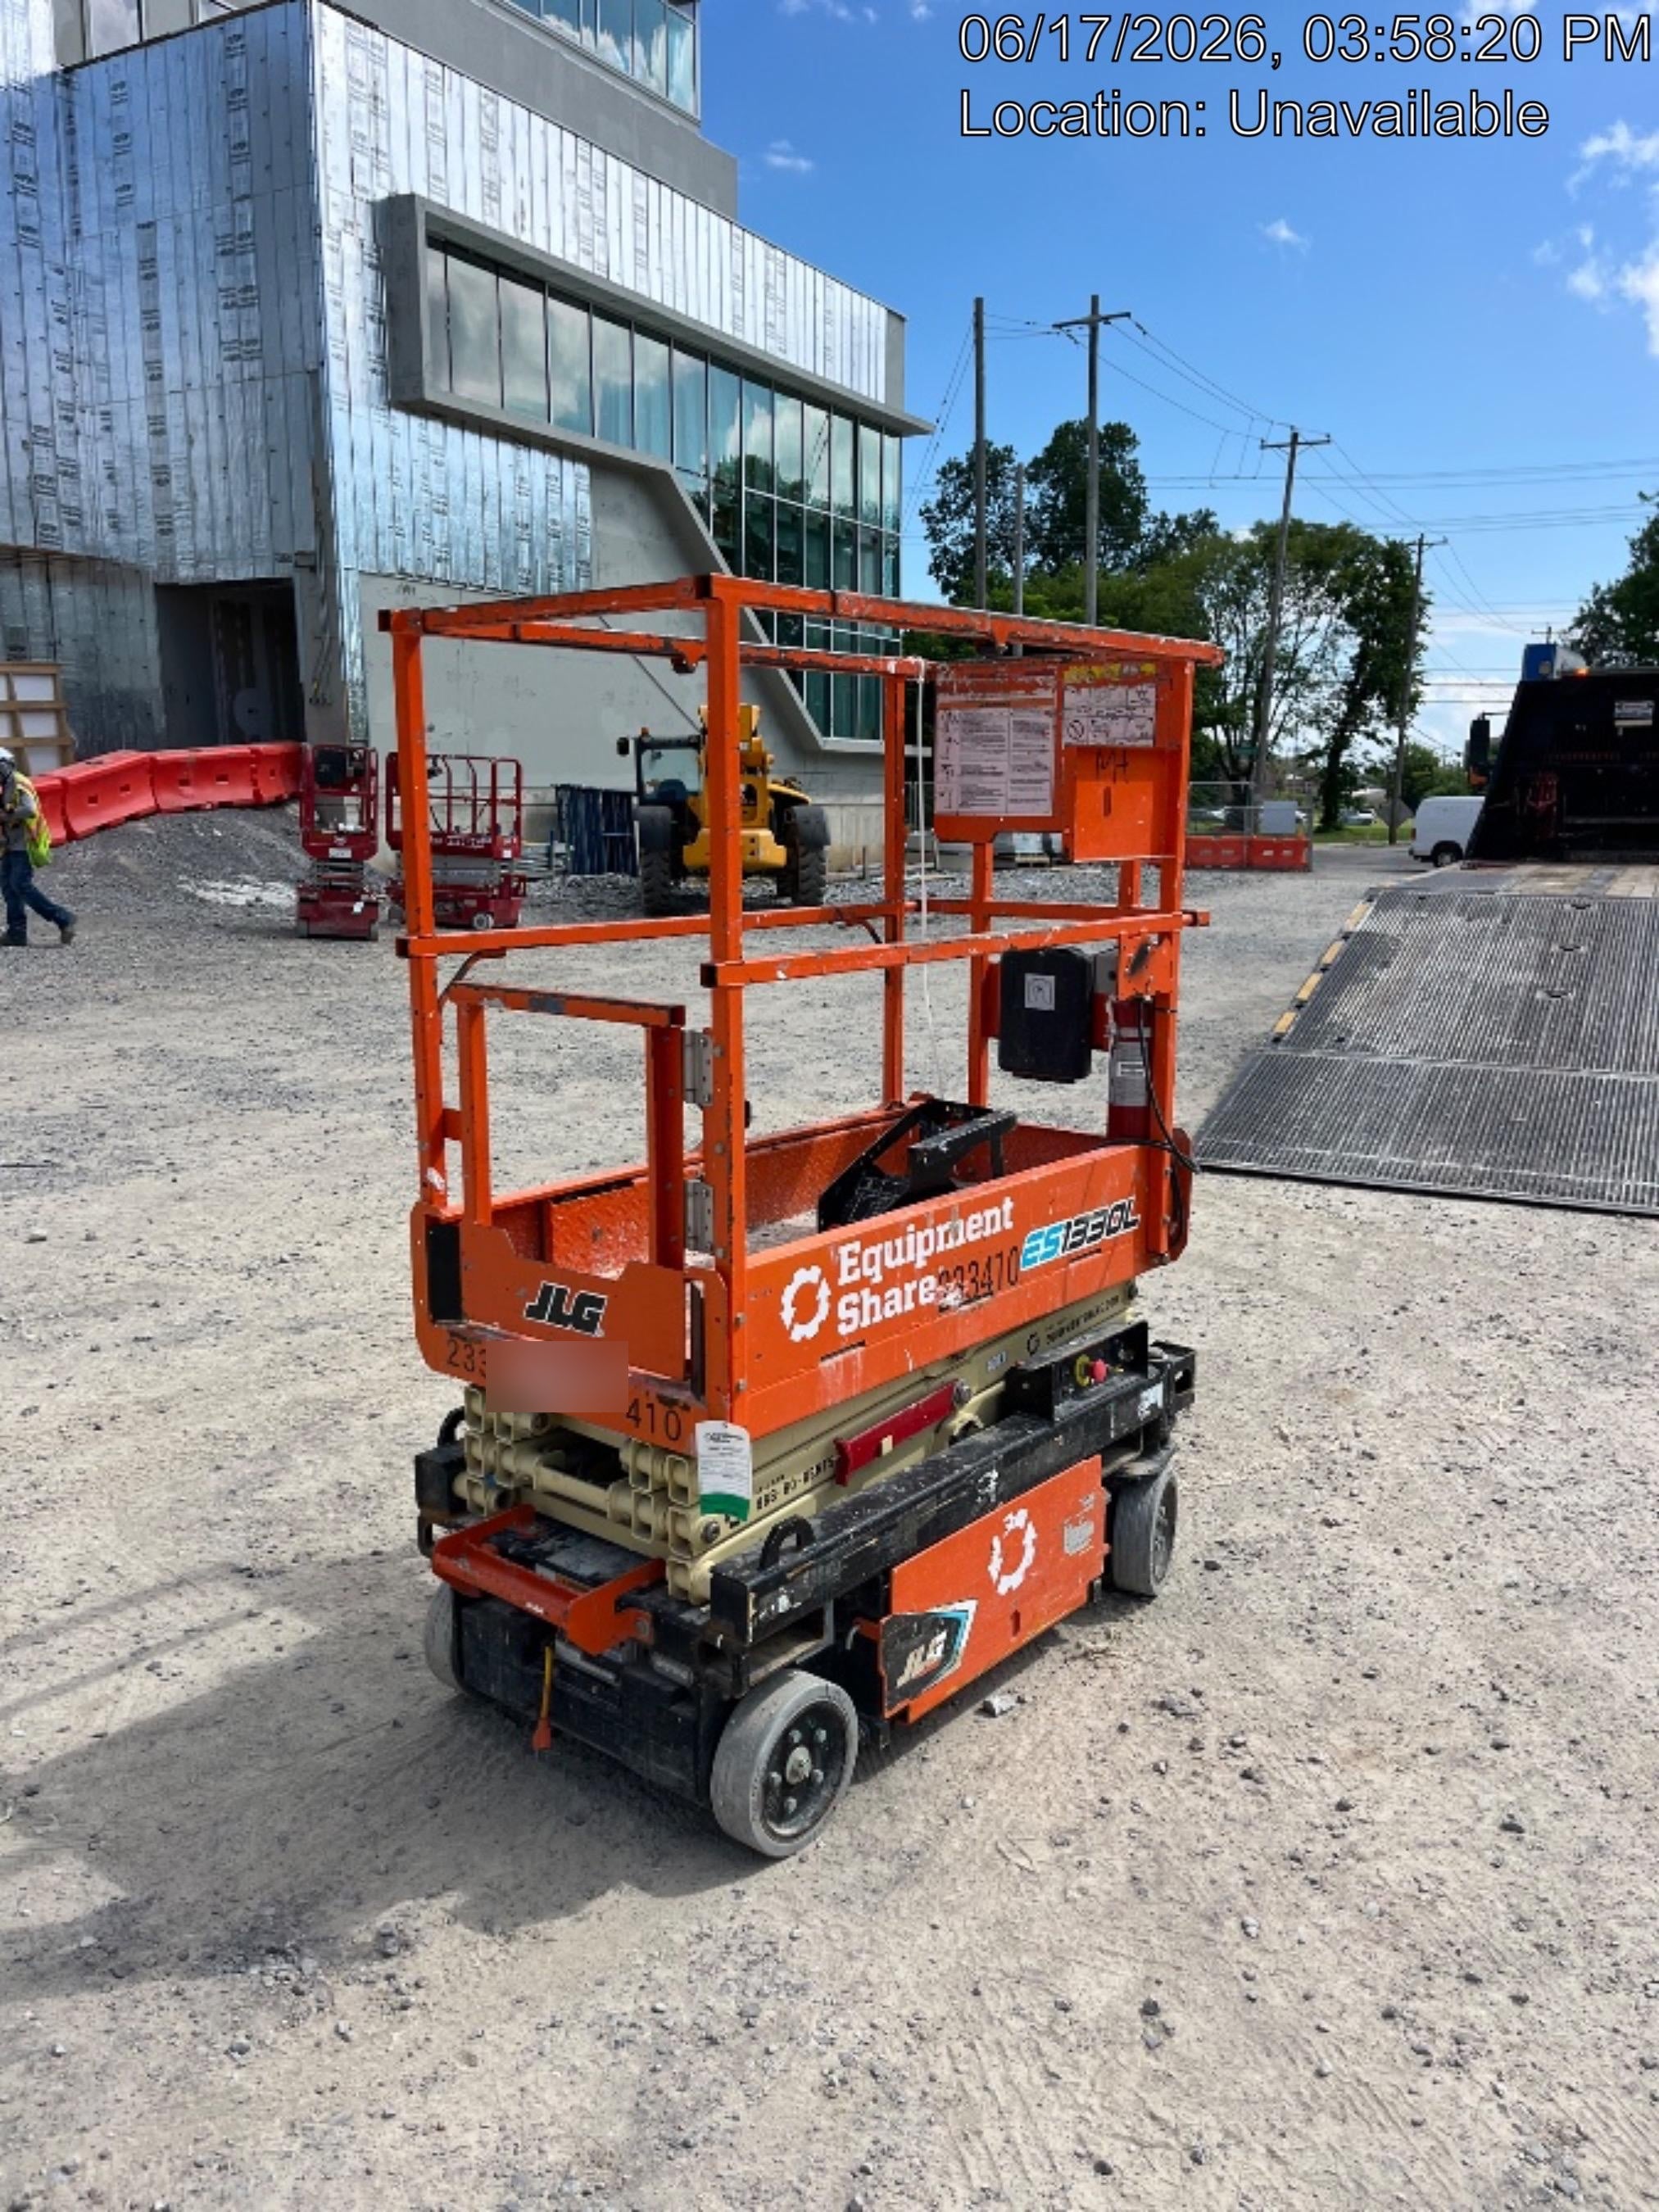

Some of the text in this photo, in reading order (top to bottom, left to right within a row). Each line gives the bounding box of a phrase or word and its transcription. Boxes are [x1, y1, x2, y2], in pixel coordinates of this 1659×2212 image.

[837, 1196, 1014, 1286] Equipment
[524, 1280, 608, 1337] JLG
[837, 1272, 936, 1336] Share
